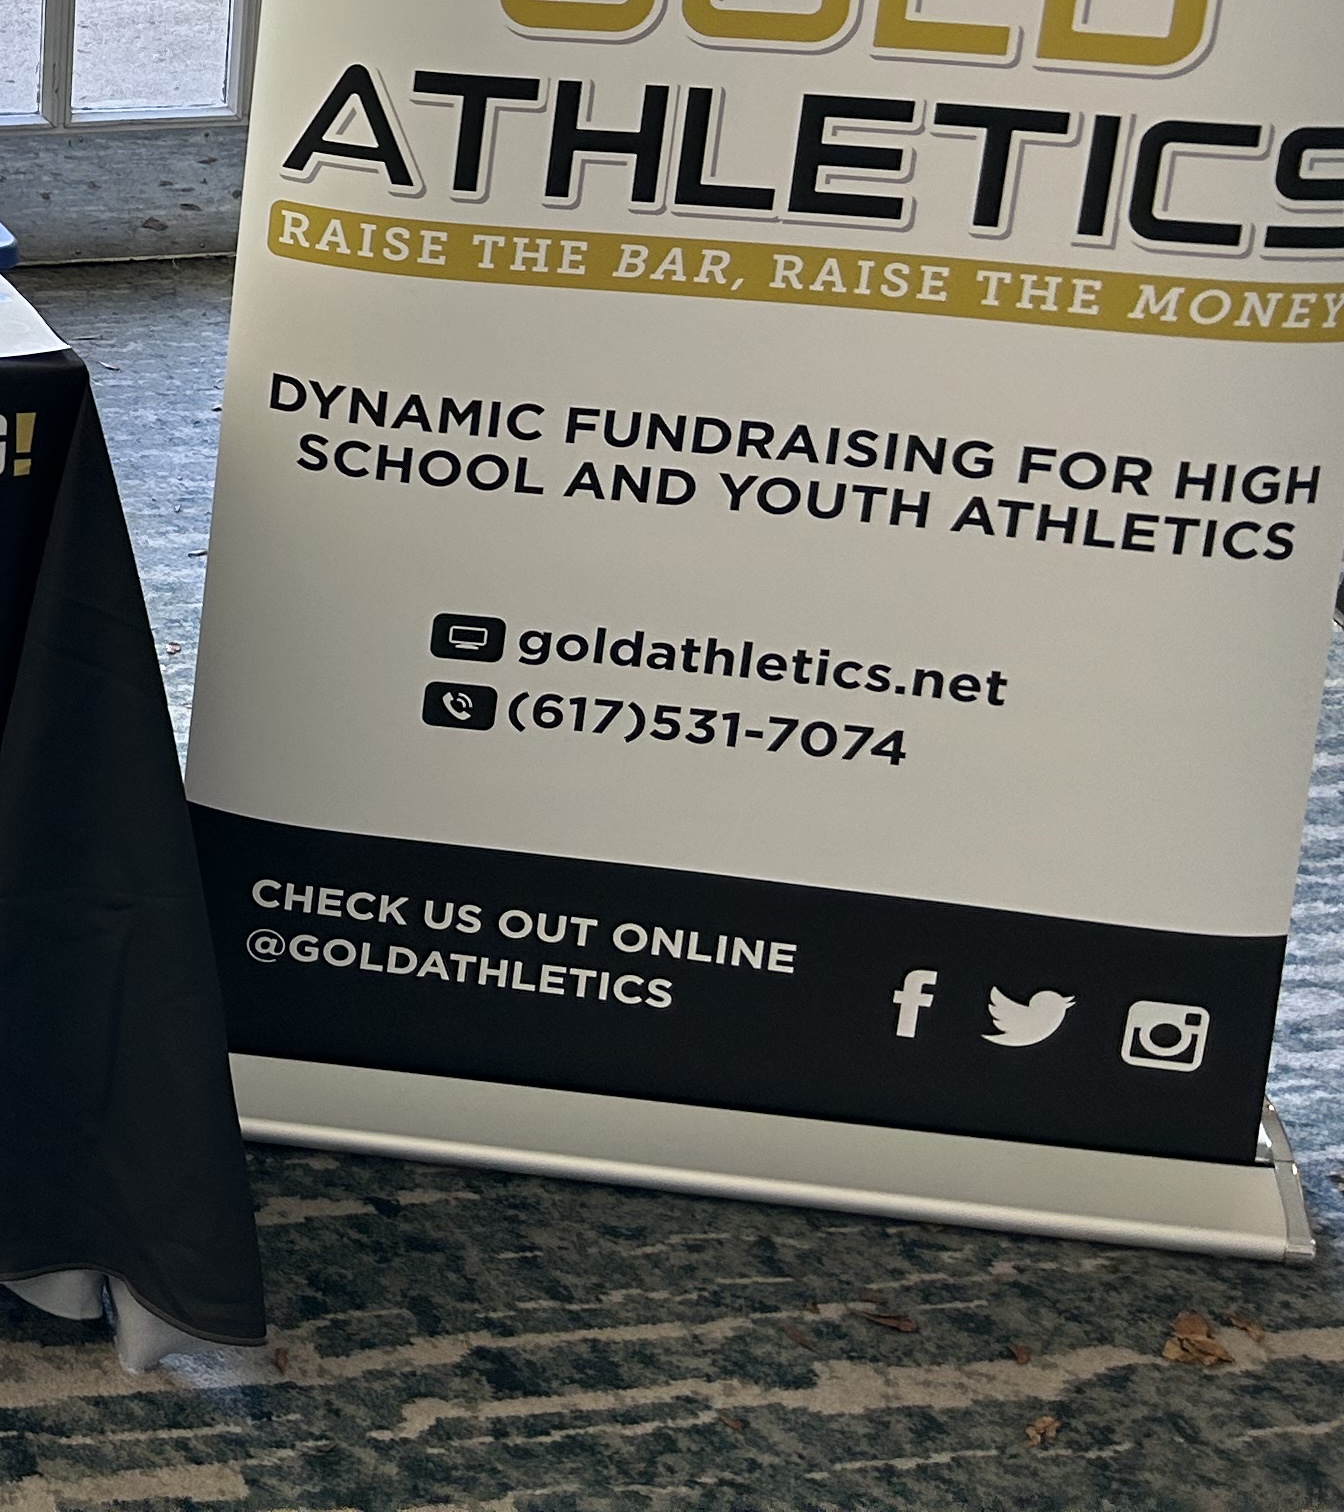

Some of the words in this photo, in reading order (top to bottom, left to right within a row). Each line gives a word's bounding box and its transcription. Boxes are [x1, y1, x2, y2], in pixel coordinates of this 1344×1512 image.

[279, 208, 449, 267] RAISE
[471, 234, 588, 276] THE
[611, 245, 750, 294] BAR,
[768, 254, 950, 304] RAISE
[975, 269, 1102, 317] THE
[1126, 284, 1344, 333] MONEY
[267, 372, 546, 444] DYNAMIC
[565, 405, 997, 482] FUNDRAISING
[1018, 446, 1154, 499] FOR
[1174, 462, 1322, 506] HIGH
[296, 433, 546, 497] SCHOOL
[563, 460, 698, 507] AND
[721, 473, 931, 531] YOUTH
[950, 496, 1296, 563] ATHLETICS
[517, 626, 1009, 707] goldathletics.net
[508, 692, 908, 766] (617)531-7074
[245, 927, 674, 1011] @GOLDATHLETICS
[251, 877, 408, 928] CHECK
[424, 897, 484, 935] US
[497, 907, 599, 950] OUT
[612, 920, 799, 977] ONLINE
